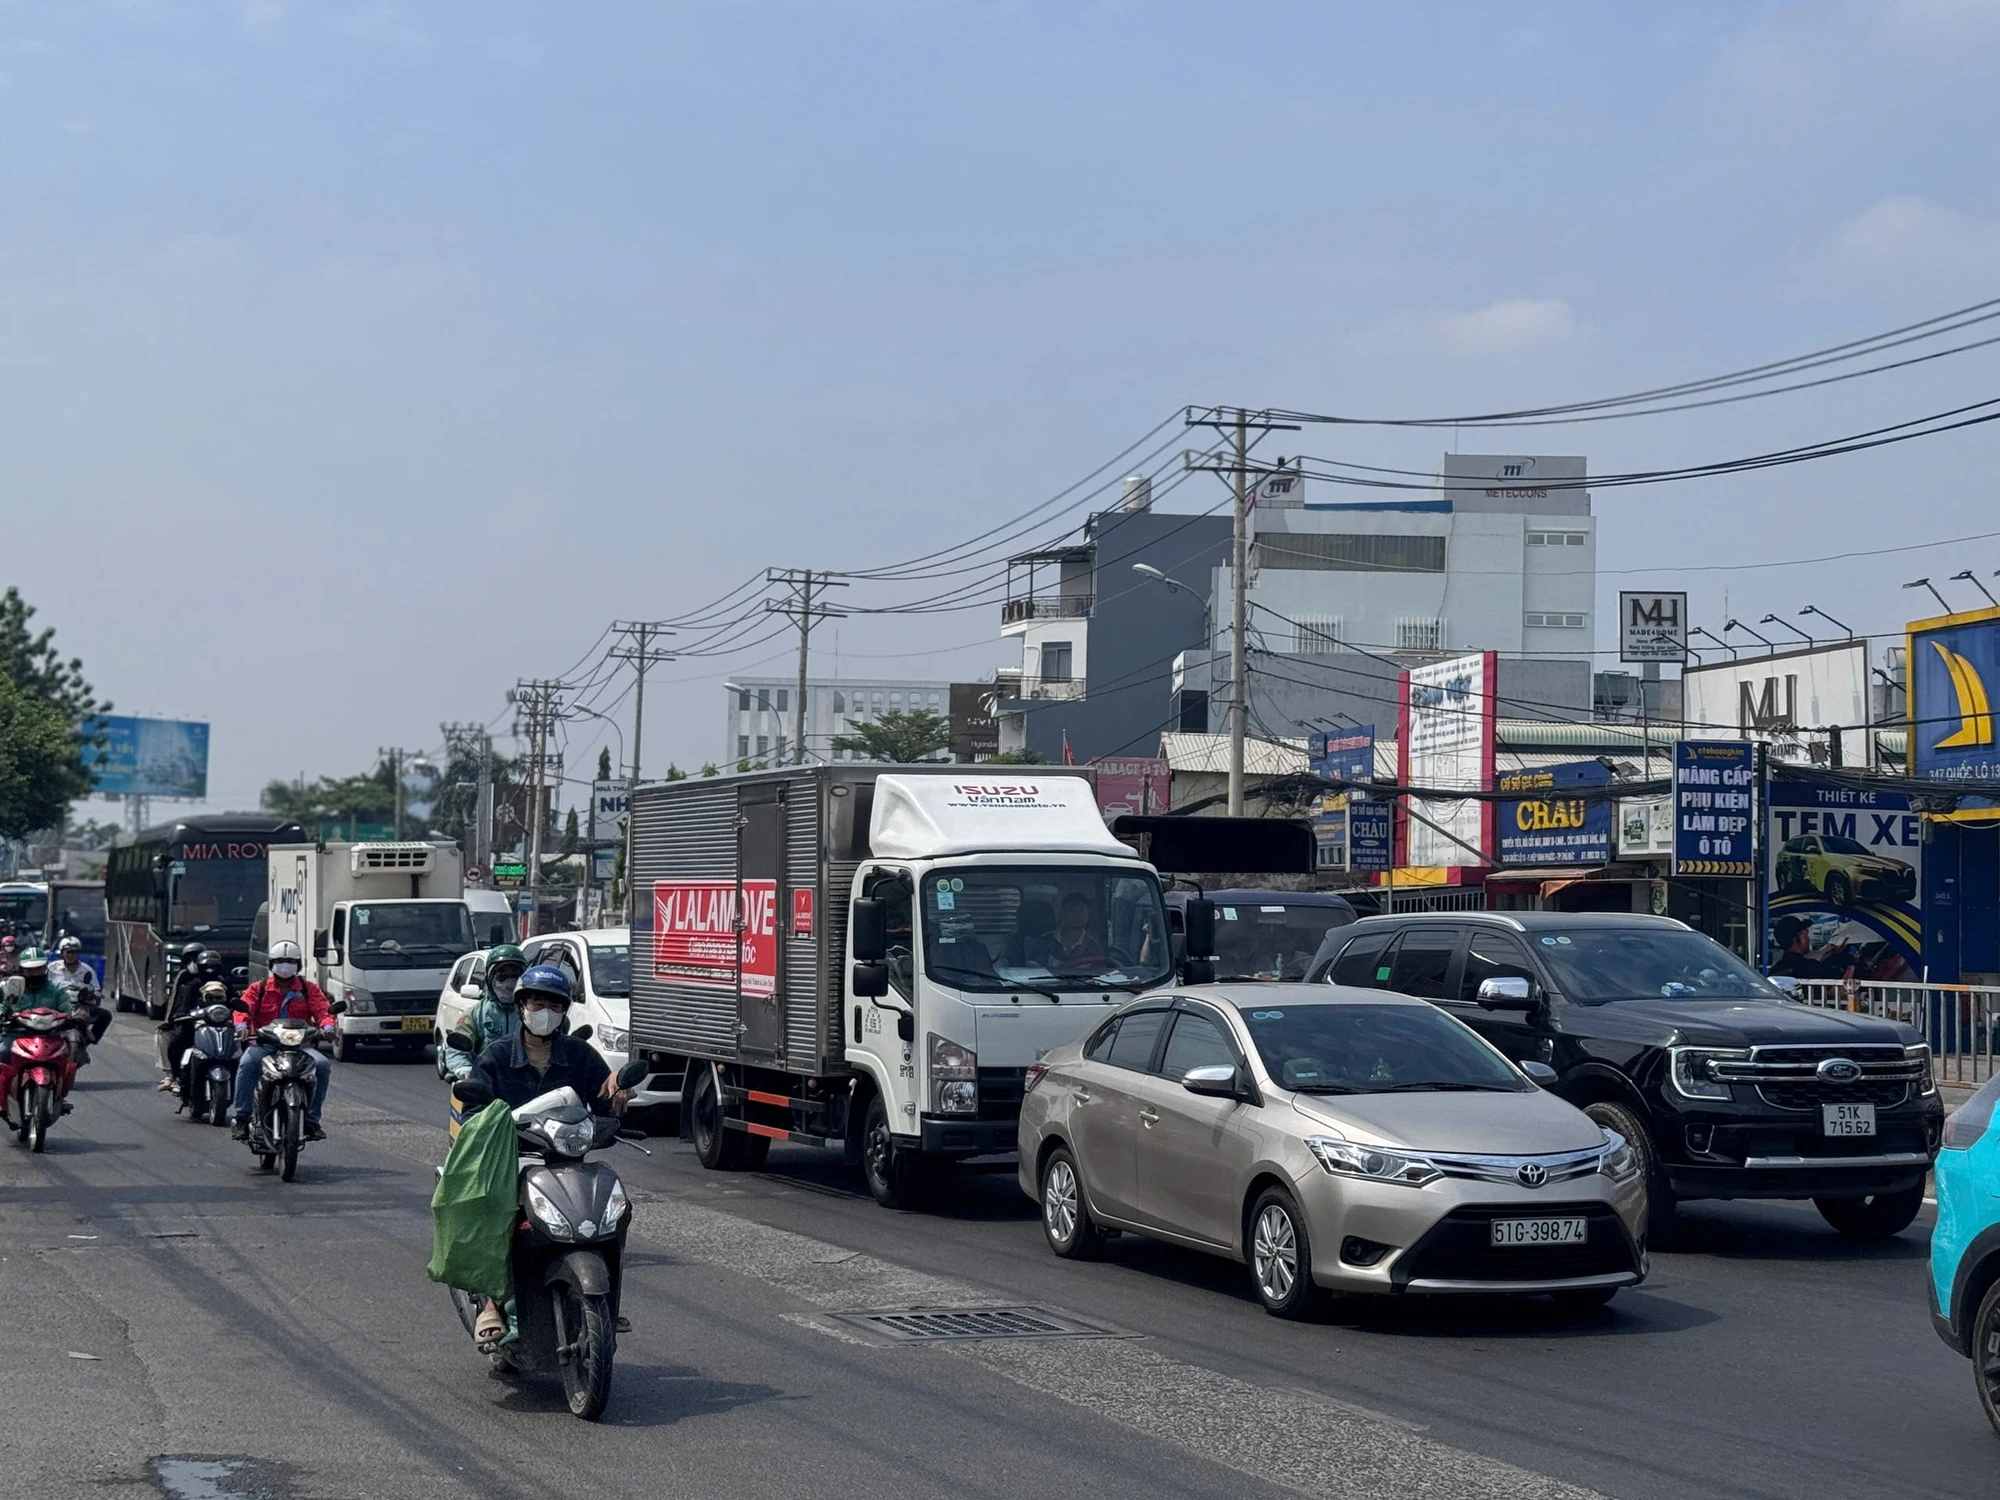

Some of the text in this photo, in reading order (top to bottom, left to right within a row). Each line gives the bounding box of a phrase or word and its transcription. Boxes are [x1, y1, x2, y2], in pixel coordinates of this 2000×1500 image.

[1096, 762, 1140, 775] GARAGE
[1152, 762, 1168, 776] TÔ
[1679, 764, 1752, 786] NÂNG CẤP
[596, 784, 611, 792] NHÀ
[954, 785, 1039, 796] ISUZU
[1816, 788, 1856, 803] THIẾT
[1682, 790, 1749, 812] PHỤ KIỆN
[1352, 818, 1387, 838] CHÂU
[1683, 812, 1747, 835] LÀM ĐẸP
[1774, 810, 1919, 847] TEM XE
[183, 843, 222, 860] MIA
[1699, 836, 1732, 856] Ô TÔ
[1832, 1065, 1852, 1076] Ford
[1838, 1106, 1860, 1119] 51K
[1830, 1121, 1870, 1134] 715.62
[1495, 1220, 1583, 1242] 51G-398.74
